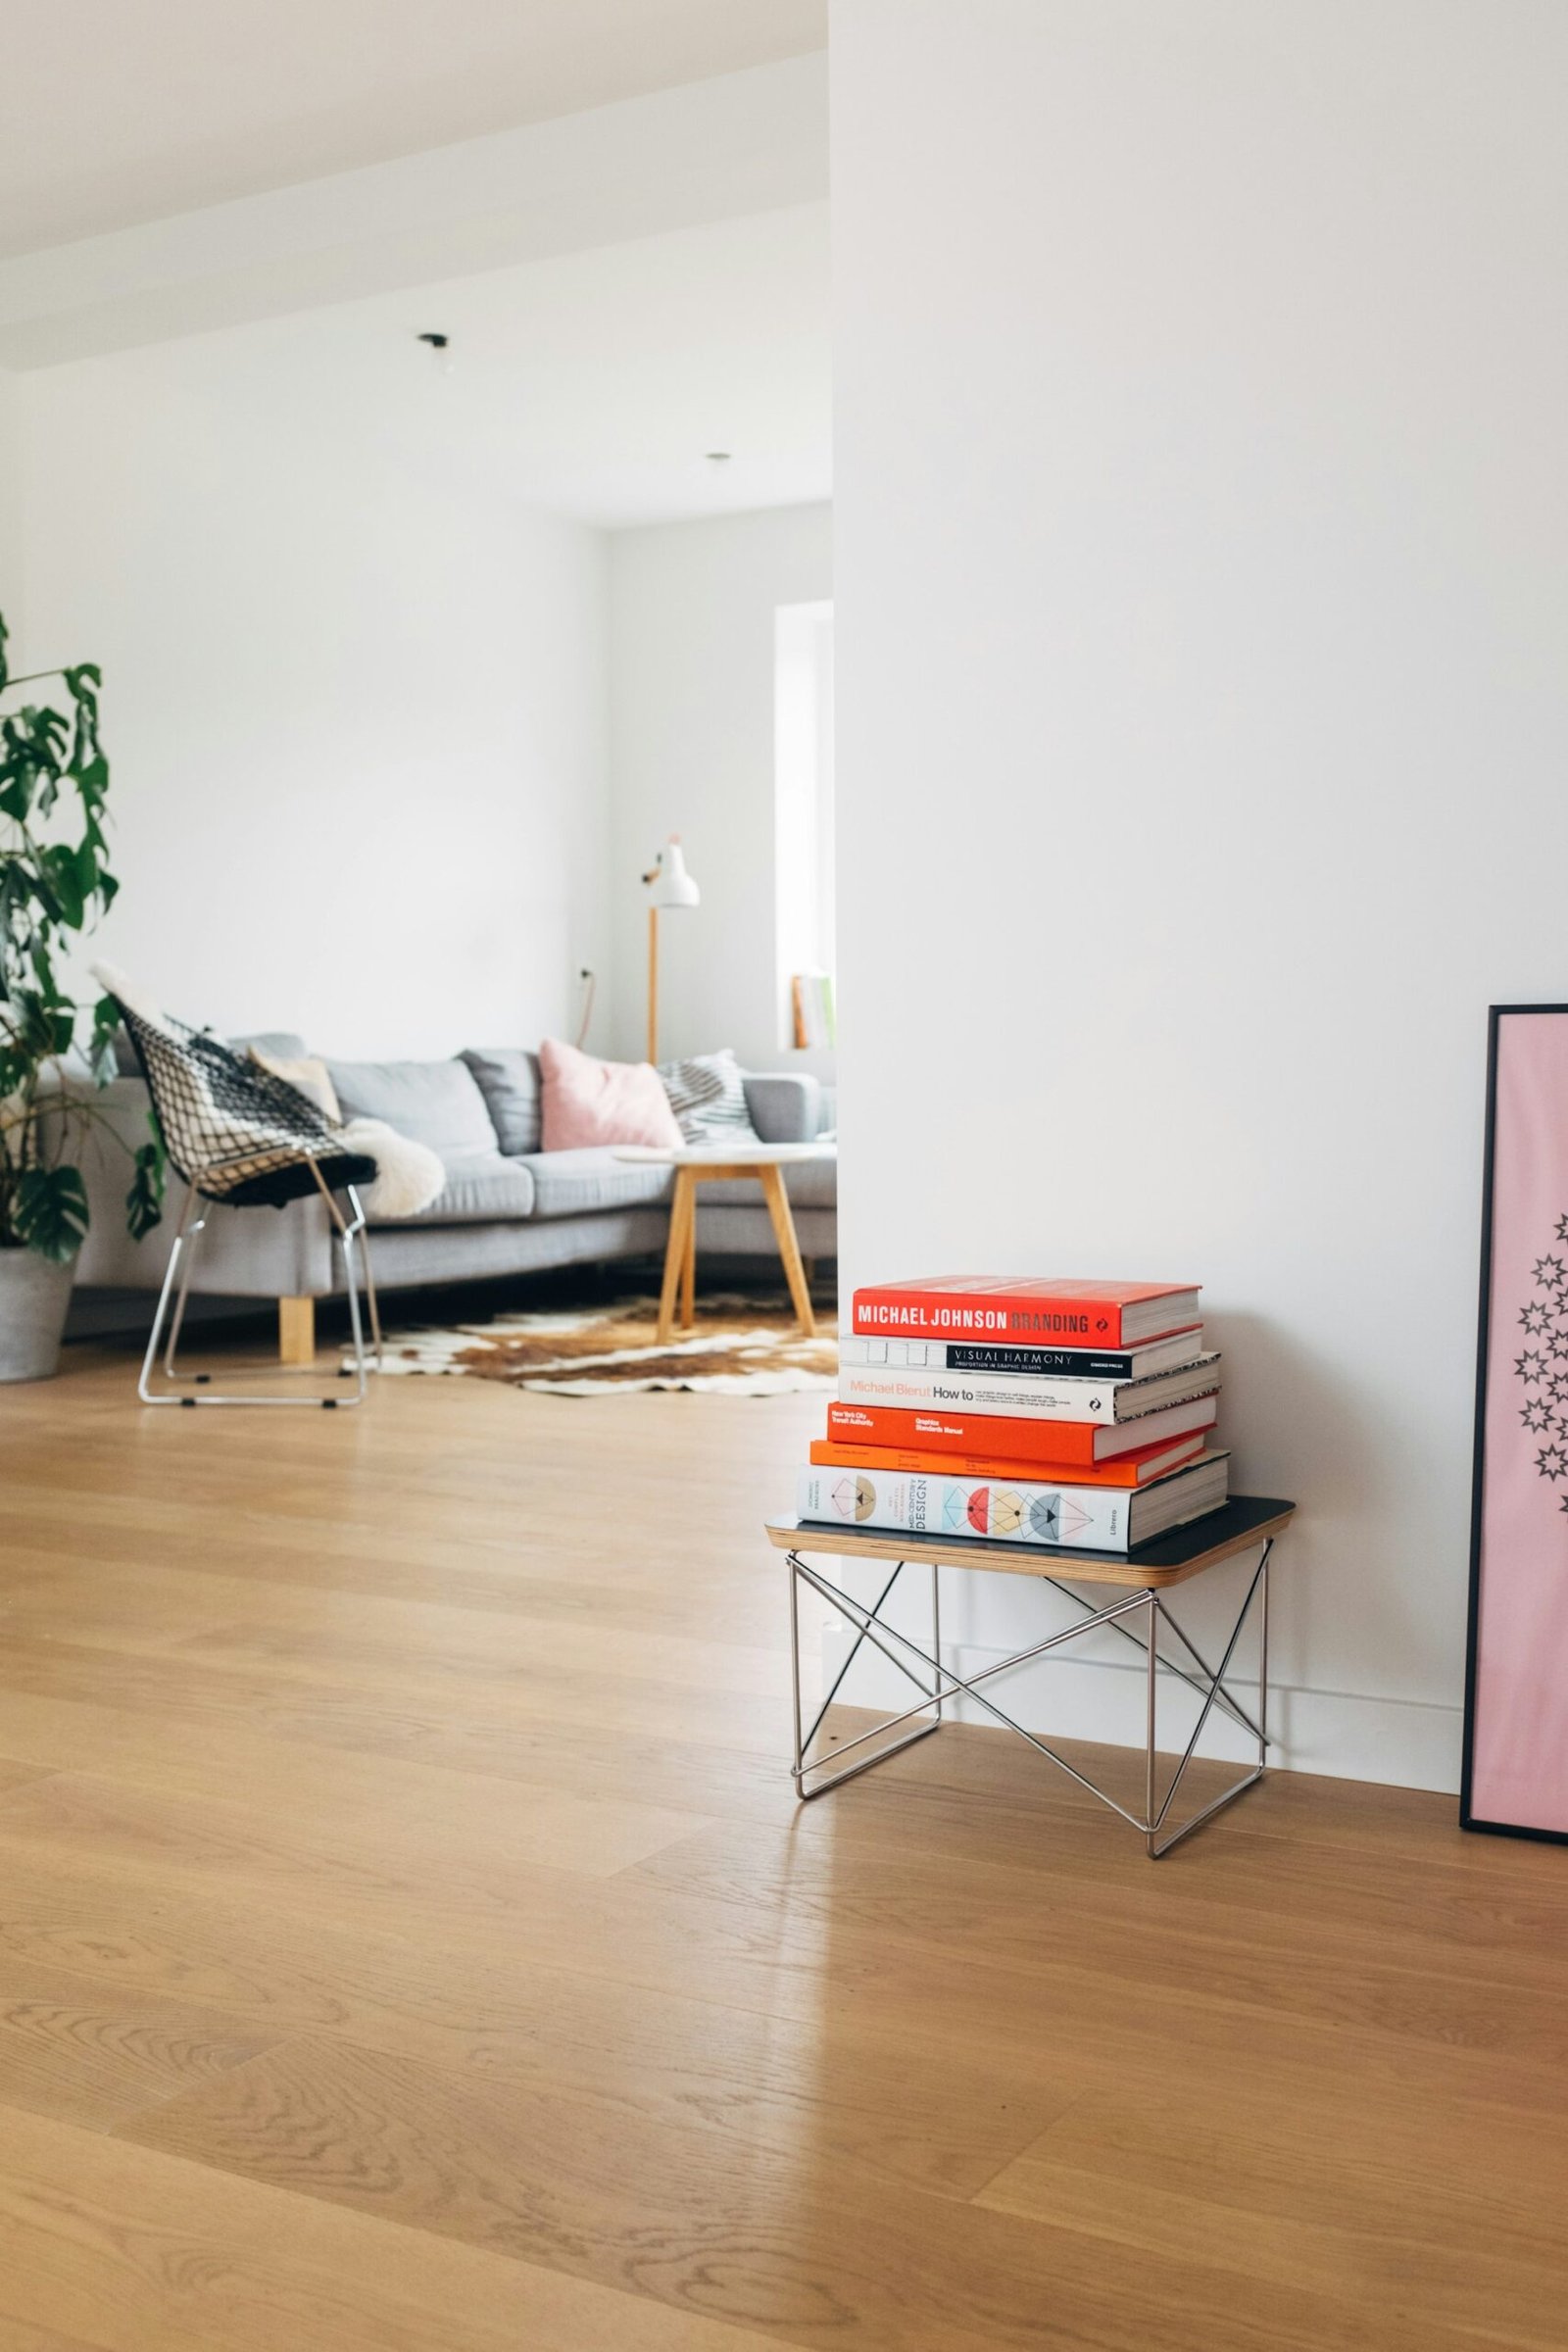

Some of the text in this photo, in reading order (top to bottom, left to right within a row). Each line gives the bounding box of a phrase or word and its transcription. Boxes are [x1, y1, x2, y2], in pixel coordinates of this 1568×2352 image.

[858, 1305, 1089, 1333] MICHAEL JOHNSON BRANDING
[955, 1349, 1073, 1365] VISUAL HARMONY
[850, 1380, 894, 1395] Michael
[897, 1384, 931, 1397] Bierut
[933, 1387, 959, 1399] How
[962, 1389, 974, 1401] to
[916, 1479, 927, 1530] DESIGN
